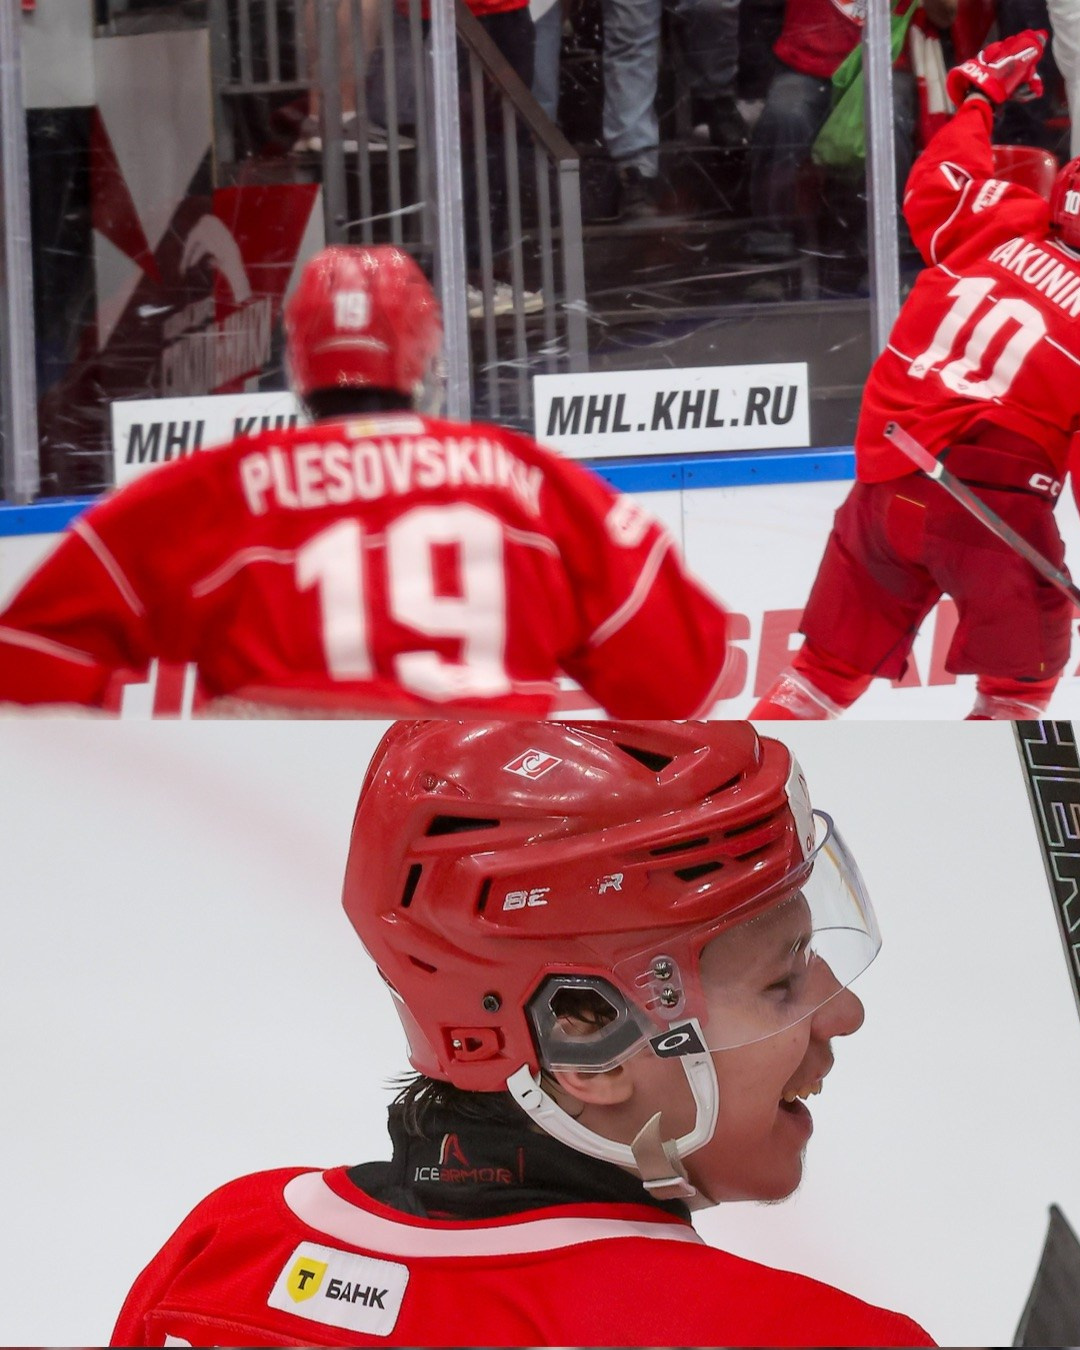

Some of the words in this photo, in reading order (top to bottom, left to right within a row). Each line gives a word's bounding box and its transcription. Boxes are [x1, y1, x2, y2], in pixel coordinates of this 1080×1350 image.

[333, 291, 368, 328] 19
[908, 277, 1047, 400] 10
[546, 385, 798, 436] MHL.KHL.RU
[296, 503, 510, 700] 19
[325, 1278, 389, 1309] БАНК
